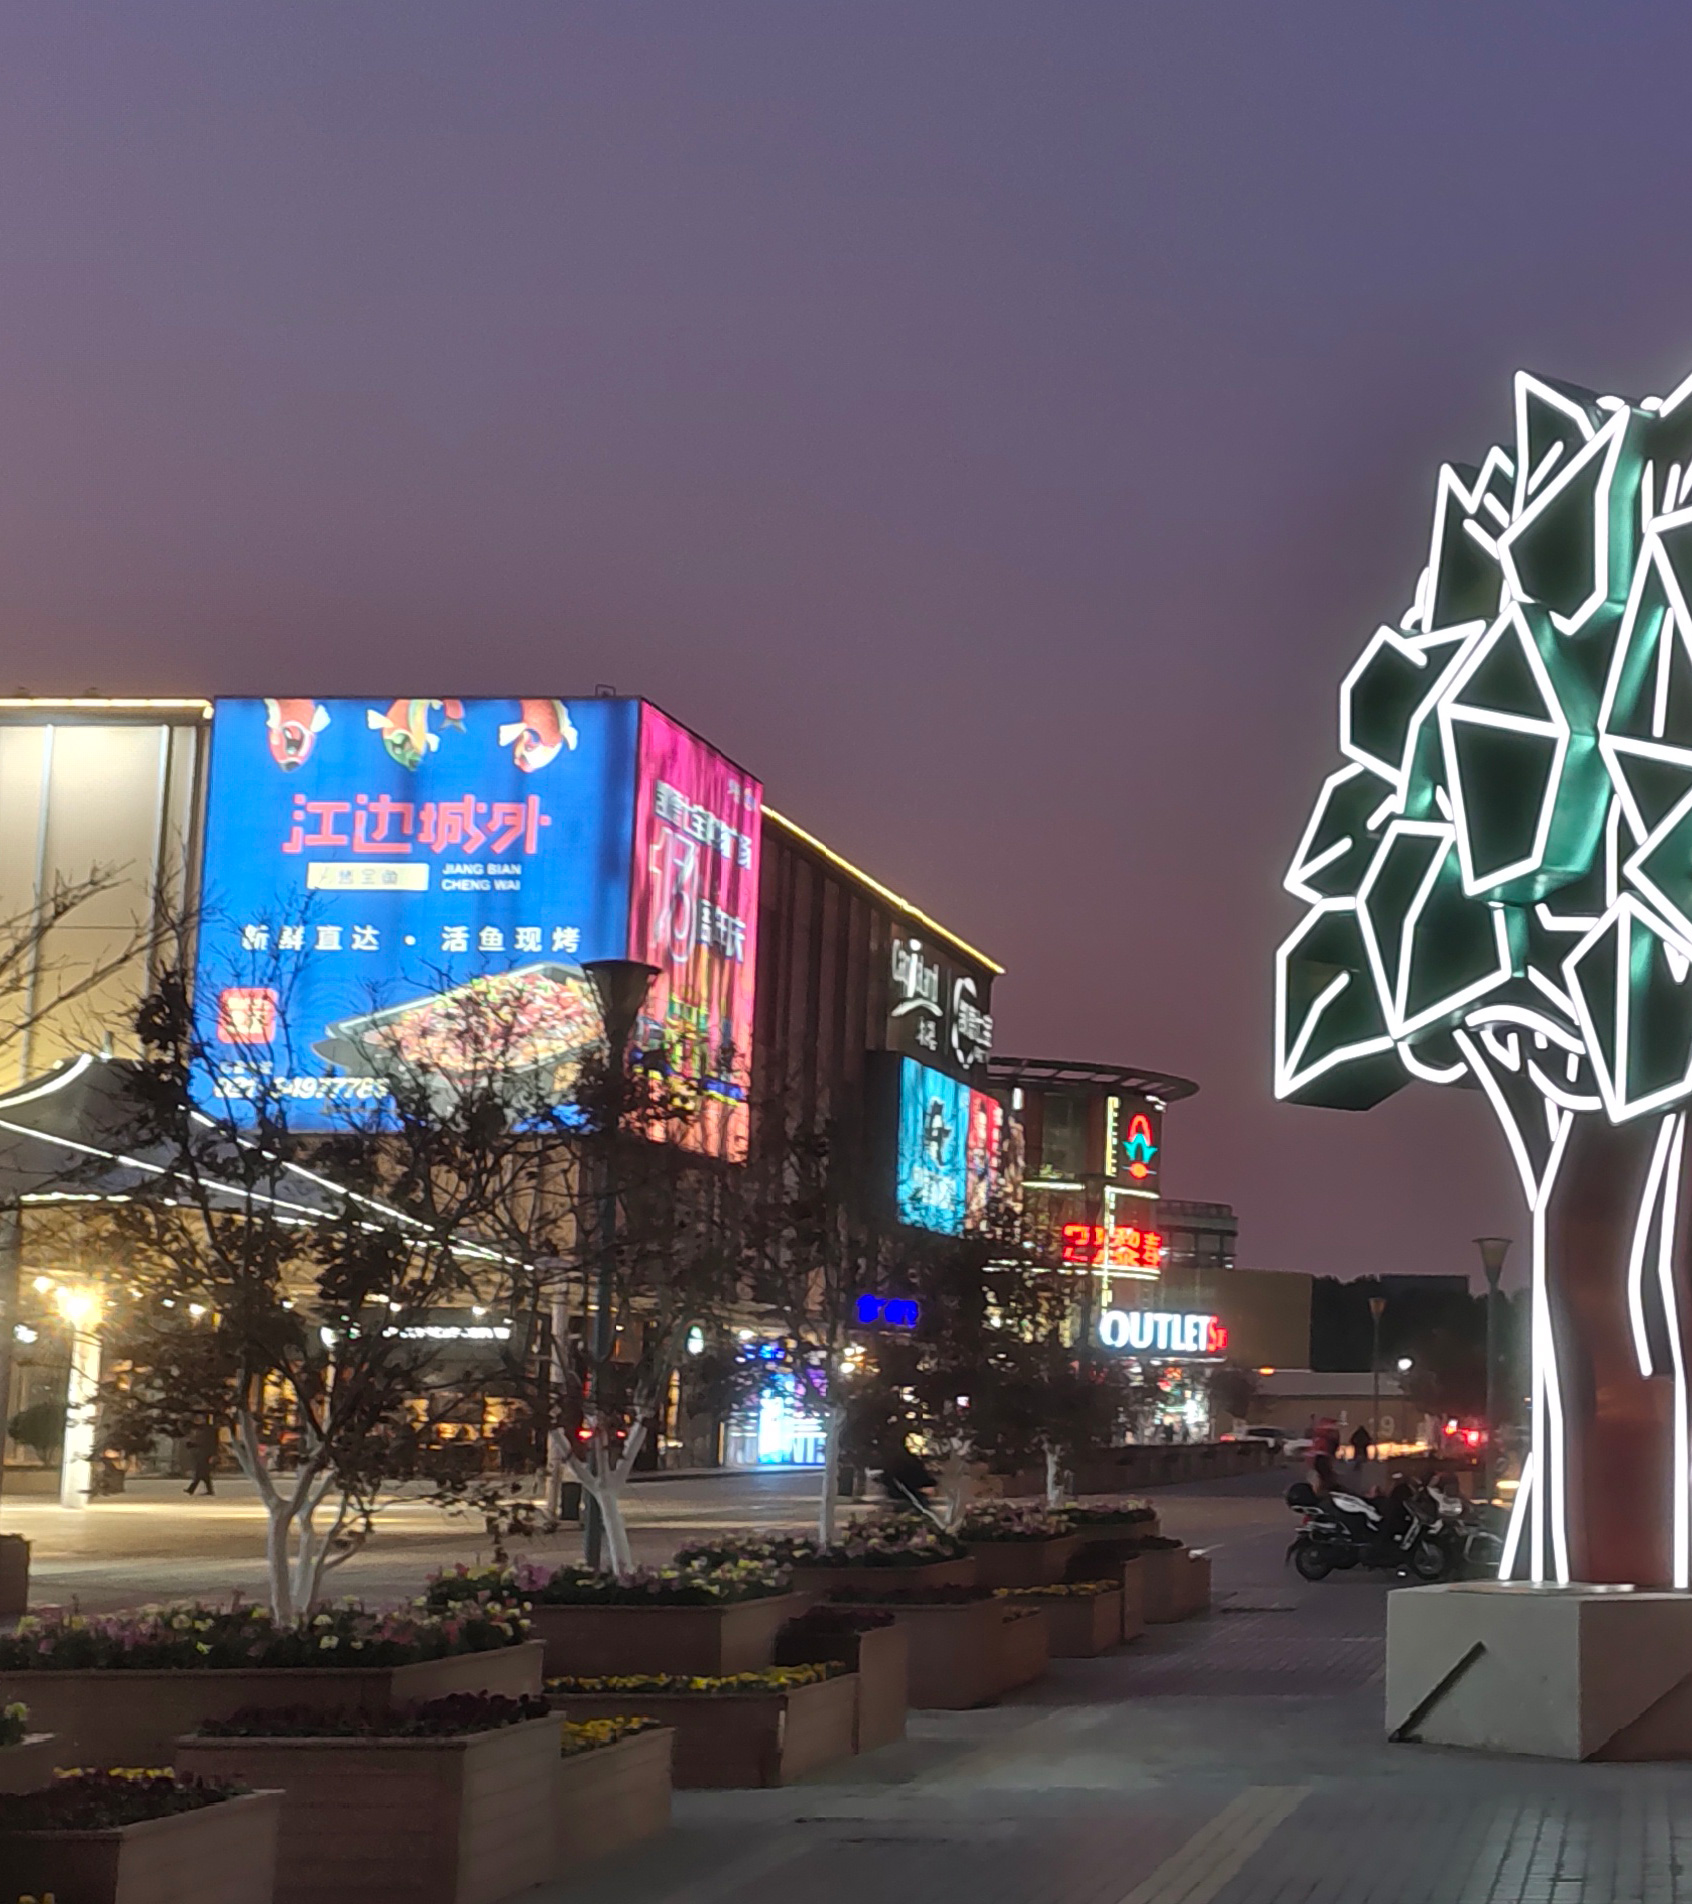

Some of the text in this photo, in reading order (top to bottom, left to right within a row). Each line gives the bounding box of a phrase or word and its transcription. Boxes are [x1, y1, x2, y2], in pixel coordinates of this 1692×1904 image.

[281, 794, 551, 855] 江边城外
[442, 863, 522, 875] JIANG BIAN
[441, 879, 521, 891] CHENG WAI
[242, 924, 582, 953] 新鲜直达 活鱼现烤
